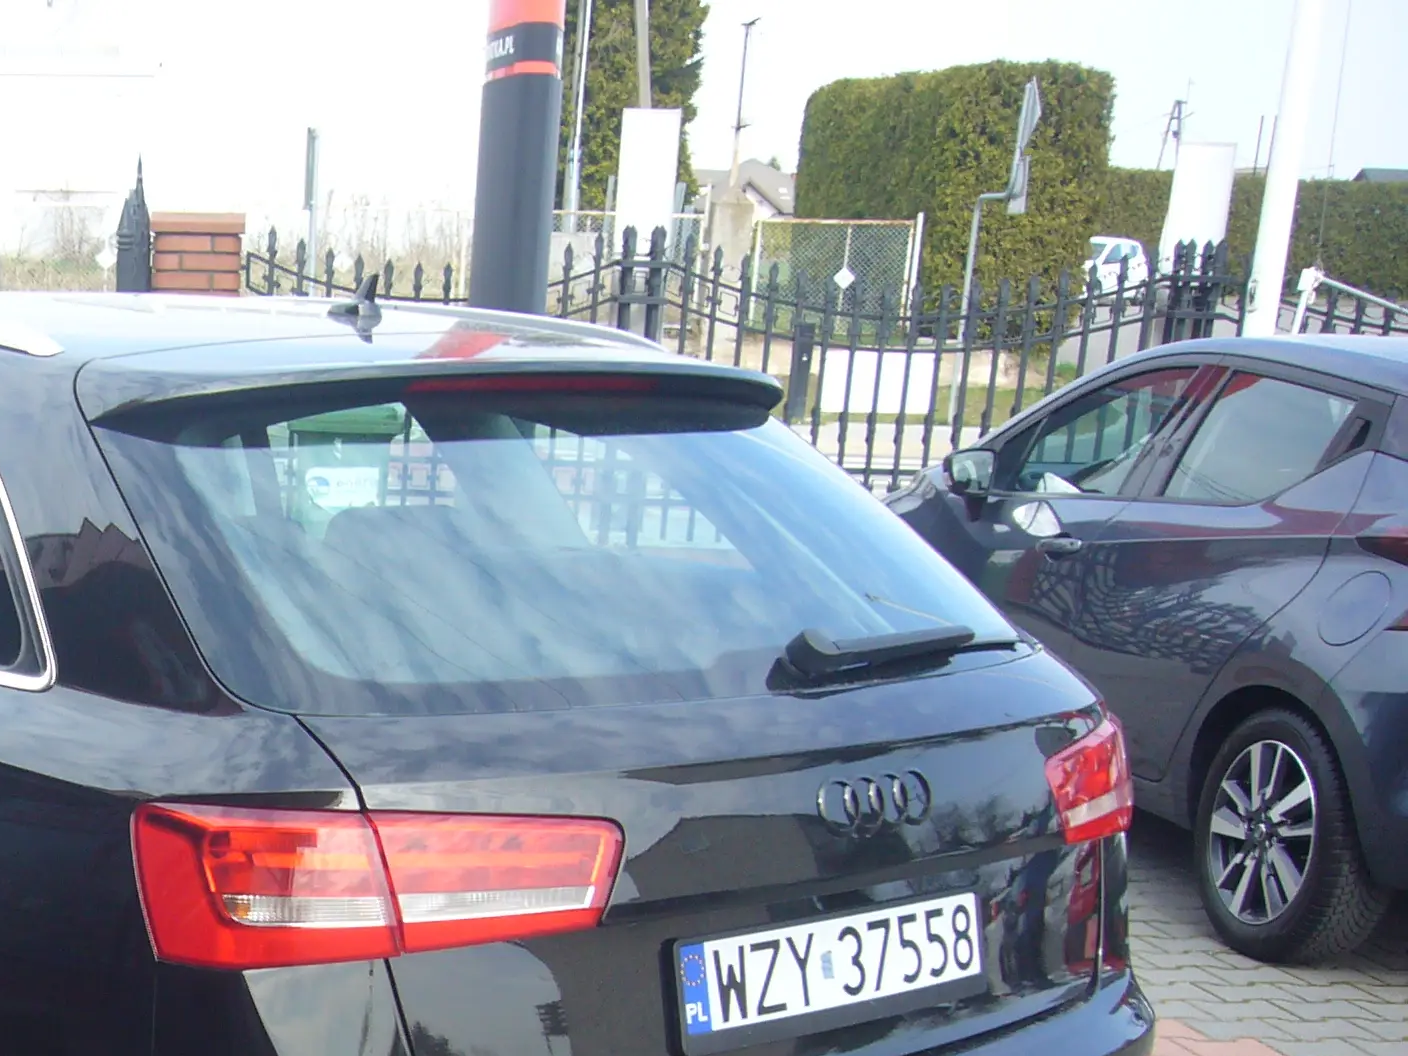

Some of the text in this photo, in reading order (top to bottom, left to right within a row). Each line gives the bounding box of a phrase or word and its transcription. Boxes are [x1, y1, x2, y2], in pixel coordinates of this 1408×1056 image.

[712, 903, 975, 1025] WZY 37558
[685, 1003, 708, 1025] PL
